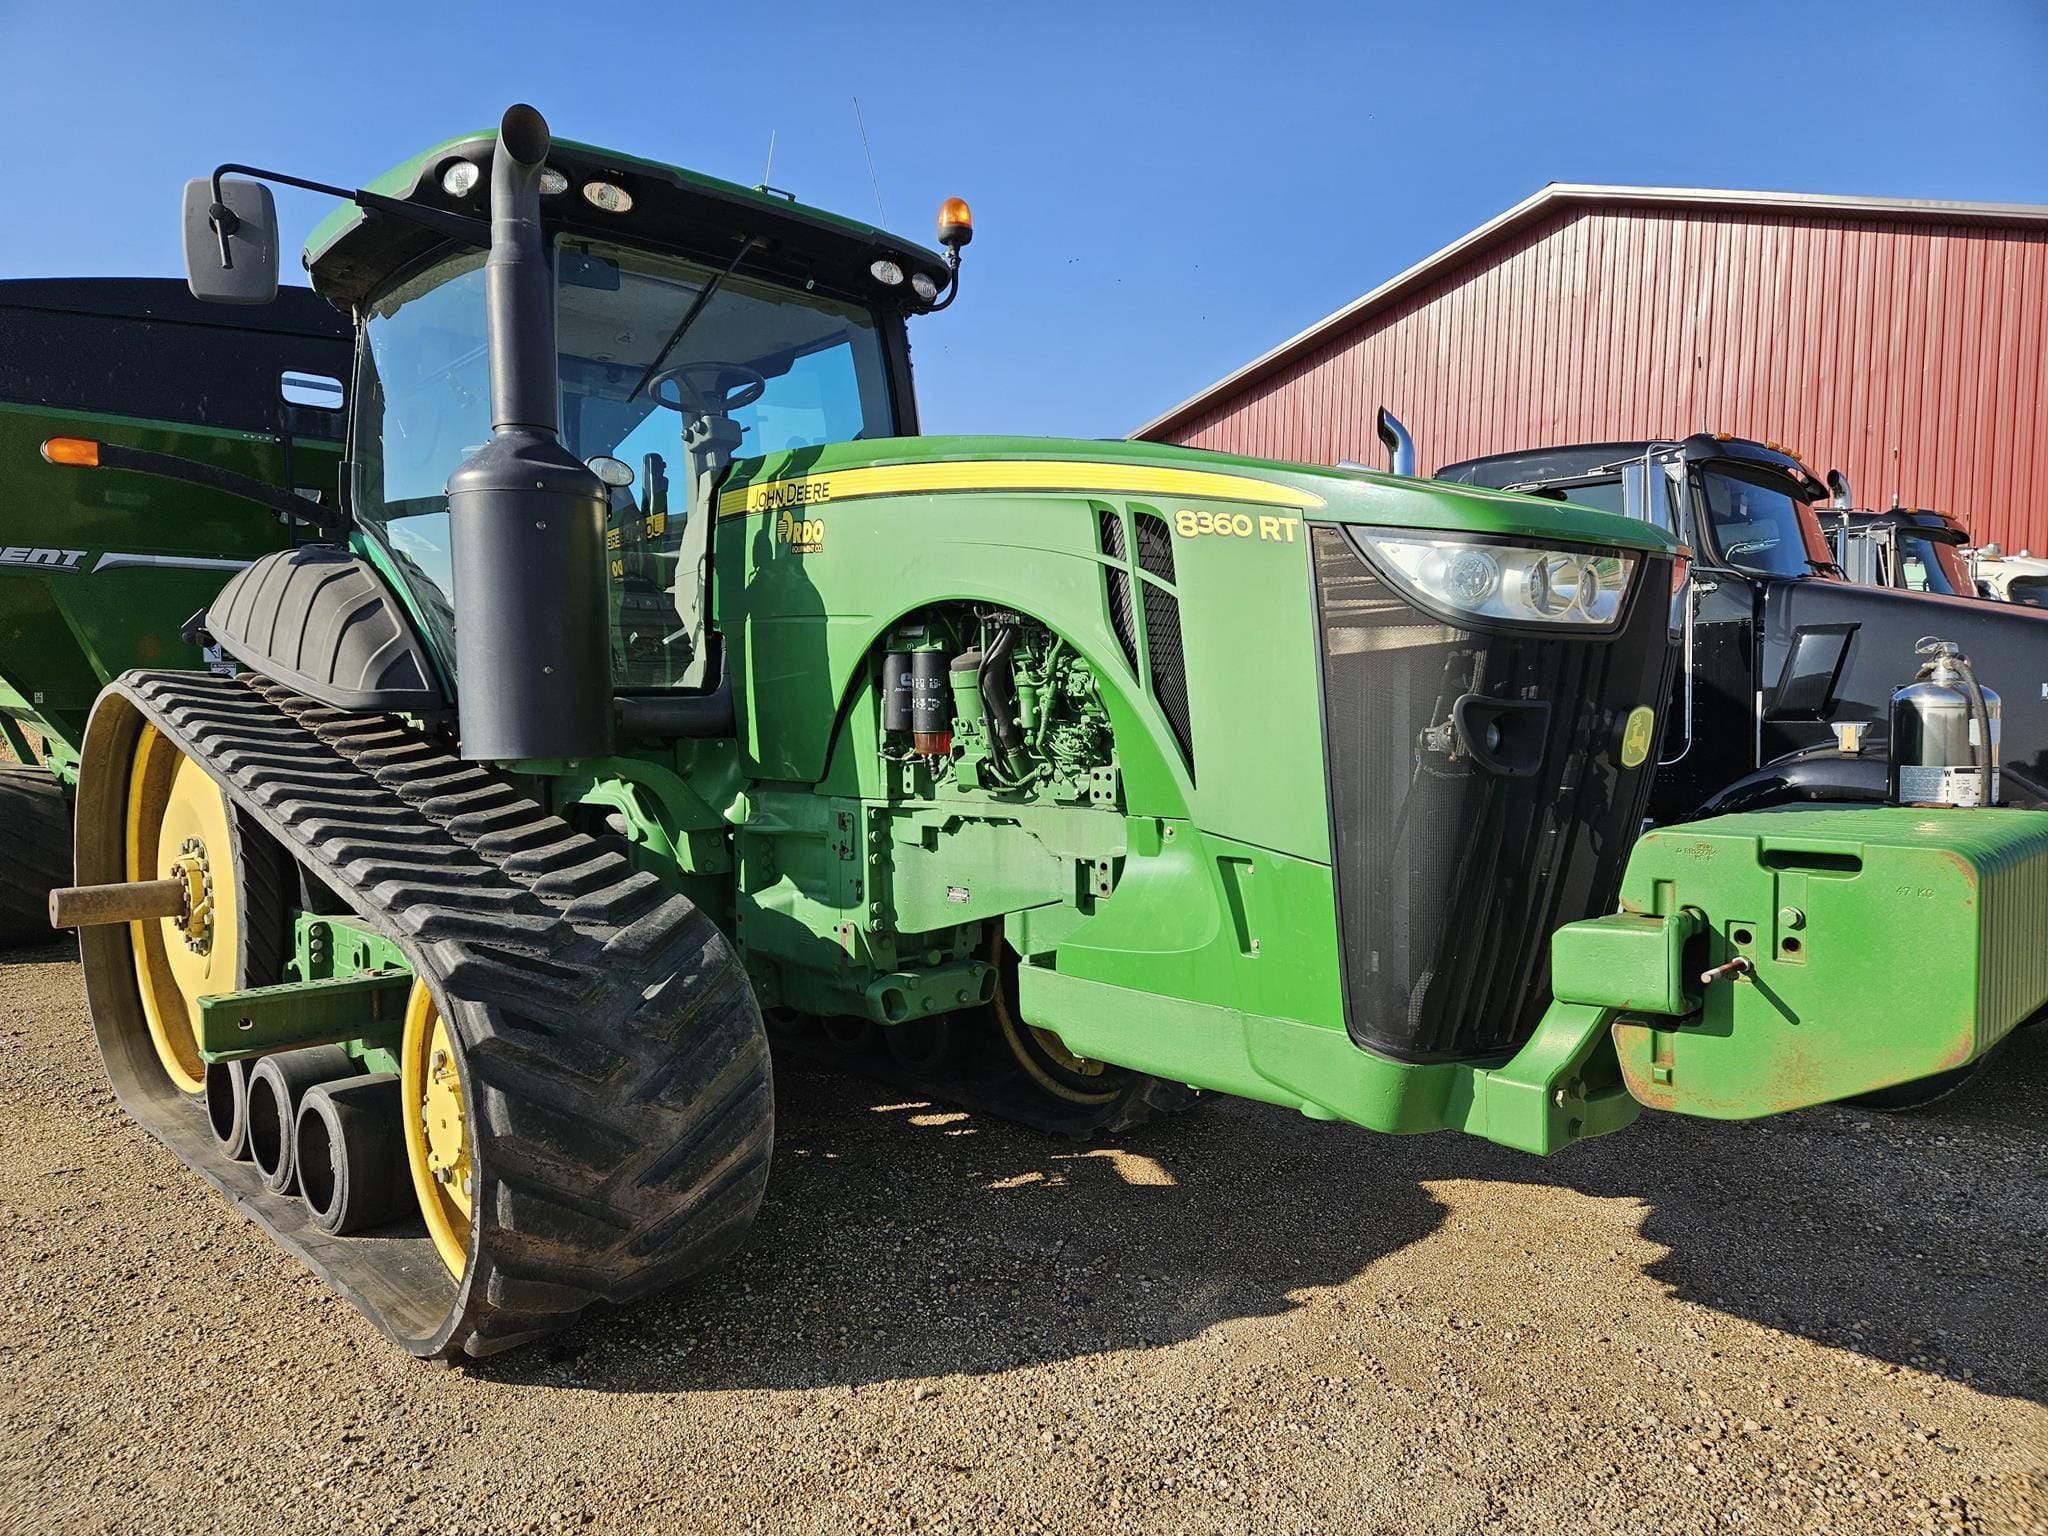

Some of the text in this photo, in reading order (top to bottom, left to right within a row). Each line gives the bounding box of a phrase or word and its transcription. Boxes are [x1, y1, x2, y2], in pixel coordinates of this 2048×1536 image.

[752, 482, 831, 509] JOHN DEERE
[1175, 509, 1299, 542] 8360 RT
[0, 546, 89, 567] ENT
[1895, 886, 1936, 898] 47 KG
